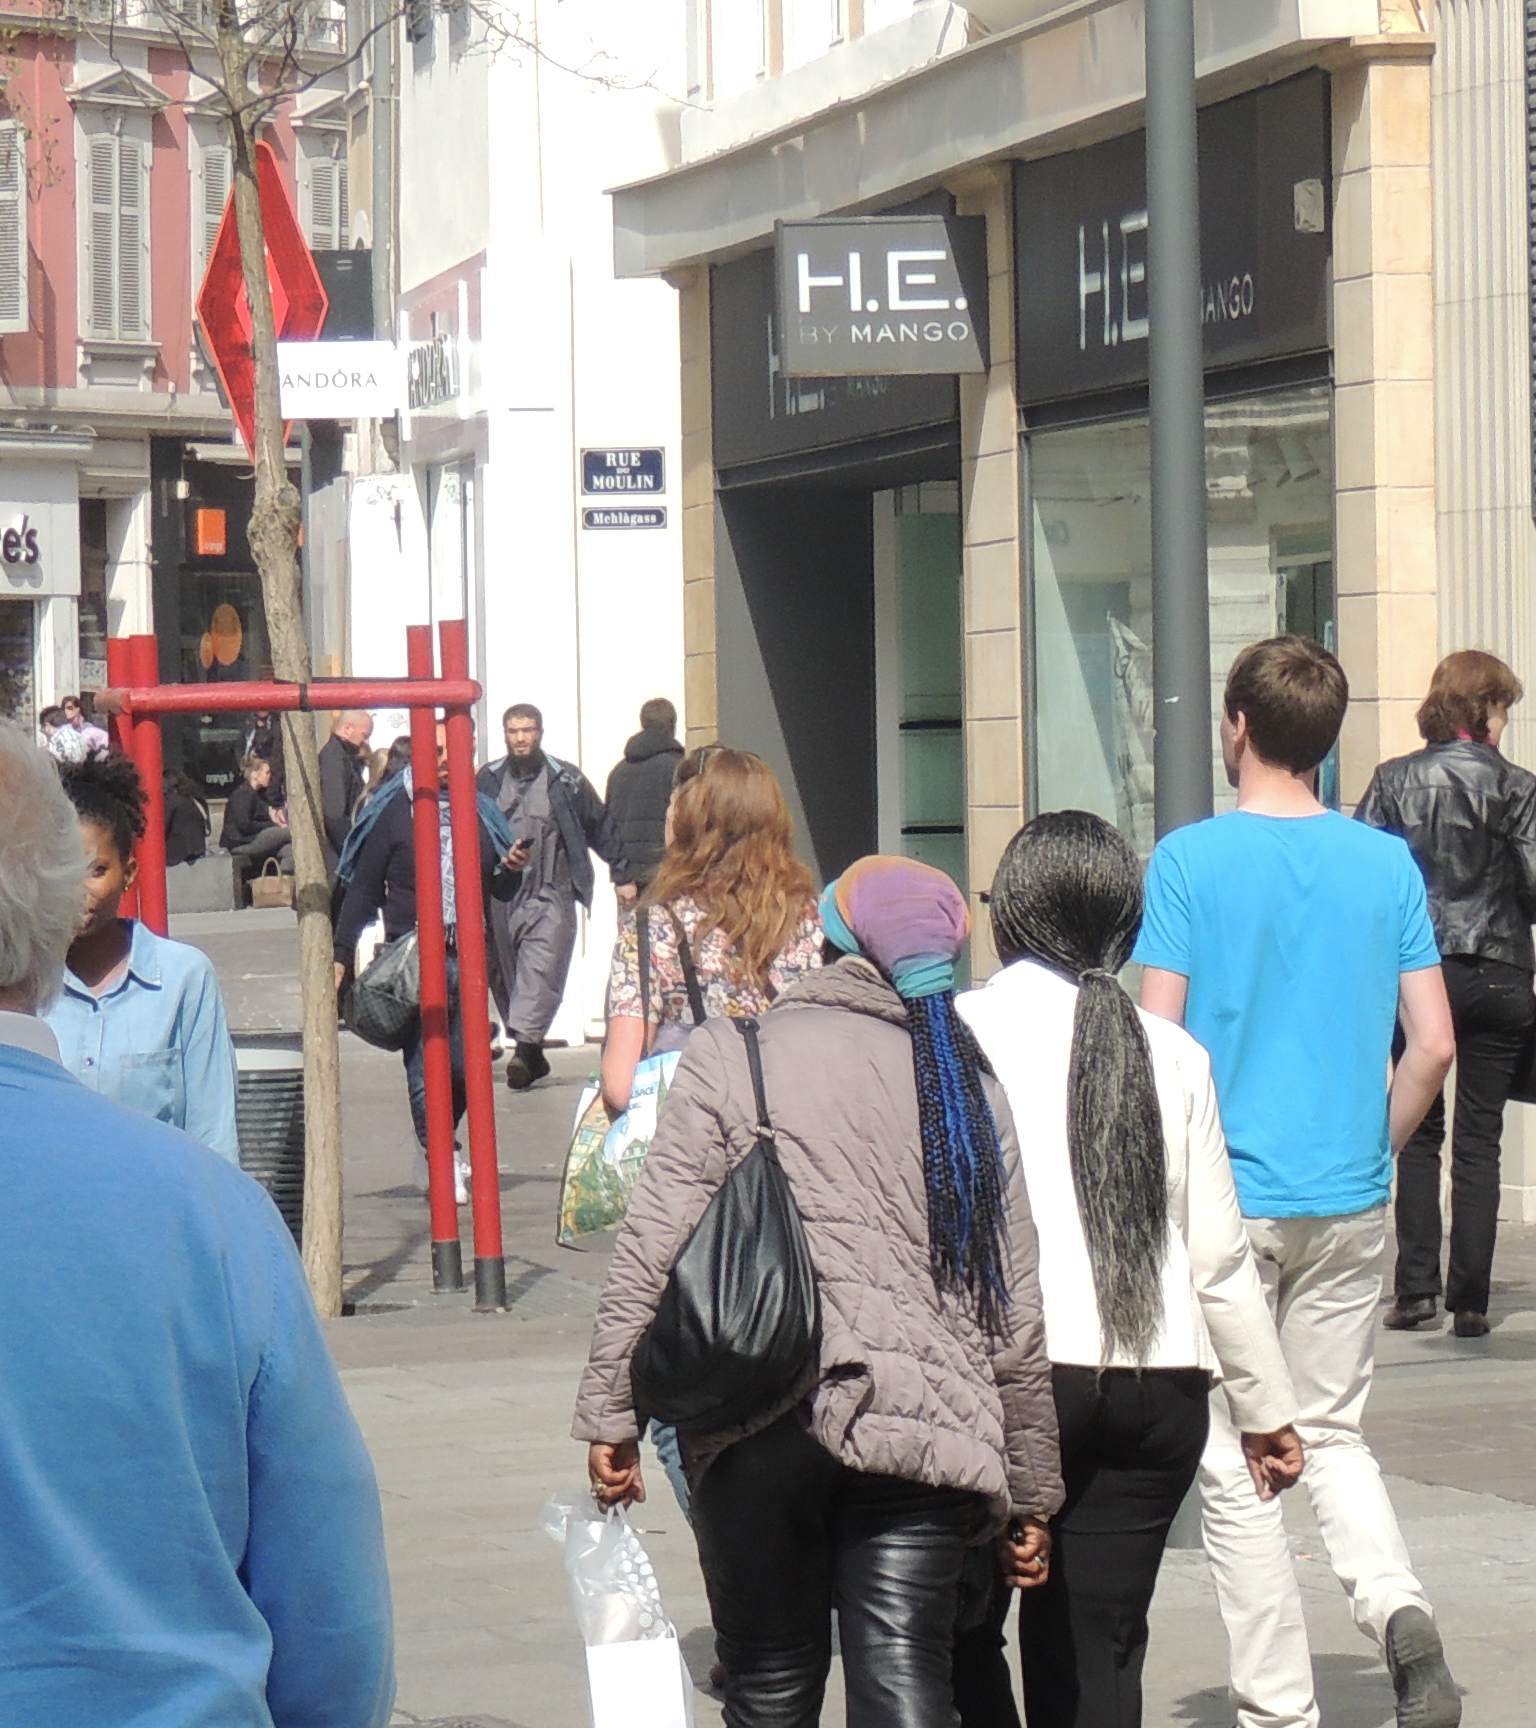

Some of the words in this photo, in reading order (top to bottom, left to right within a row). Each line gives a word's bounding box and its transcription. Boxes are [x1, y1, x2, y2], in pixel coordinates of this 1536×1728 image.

[797, 249, 968, 313] H.E.
[1201, 273, 1254, 325] ANGO
[799, 325, 838, 344] BY
[851, 321, 969, 344] MANGO
[281, 368, 378, 389] ANDORA
[606, 452, 641, 467] RUE
[592, 474, 654, 490] MOULIN
